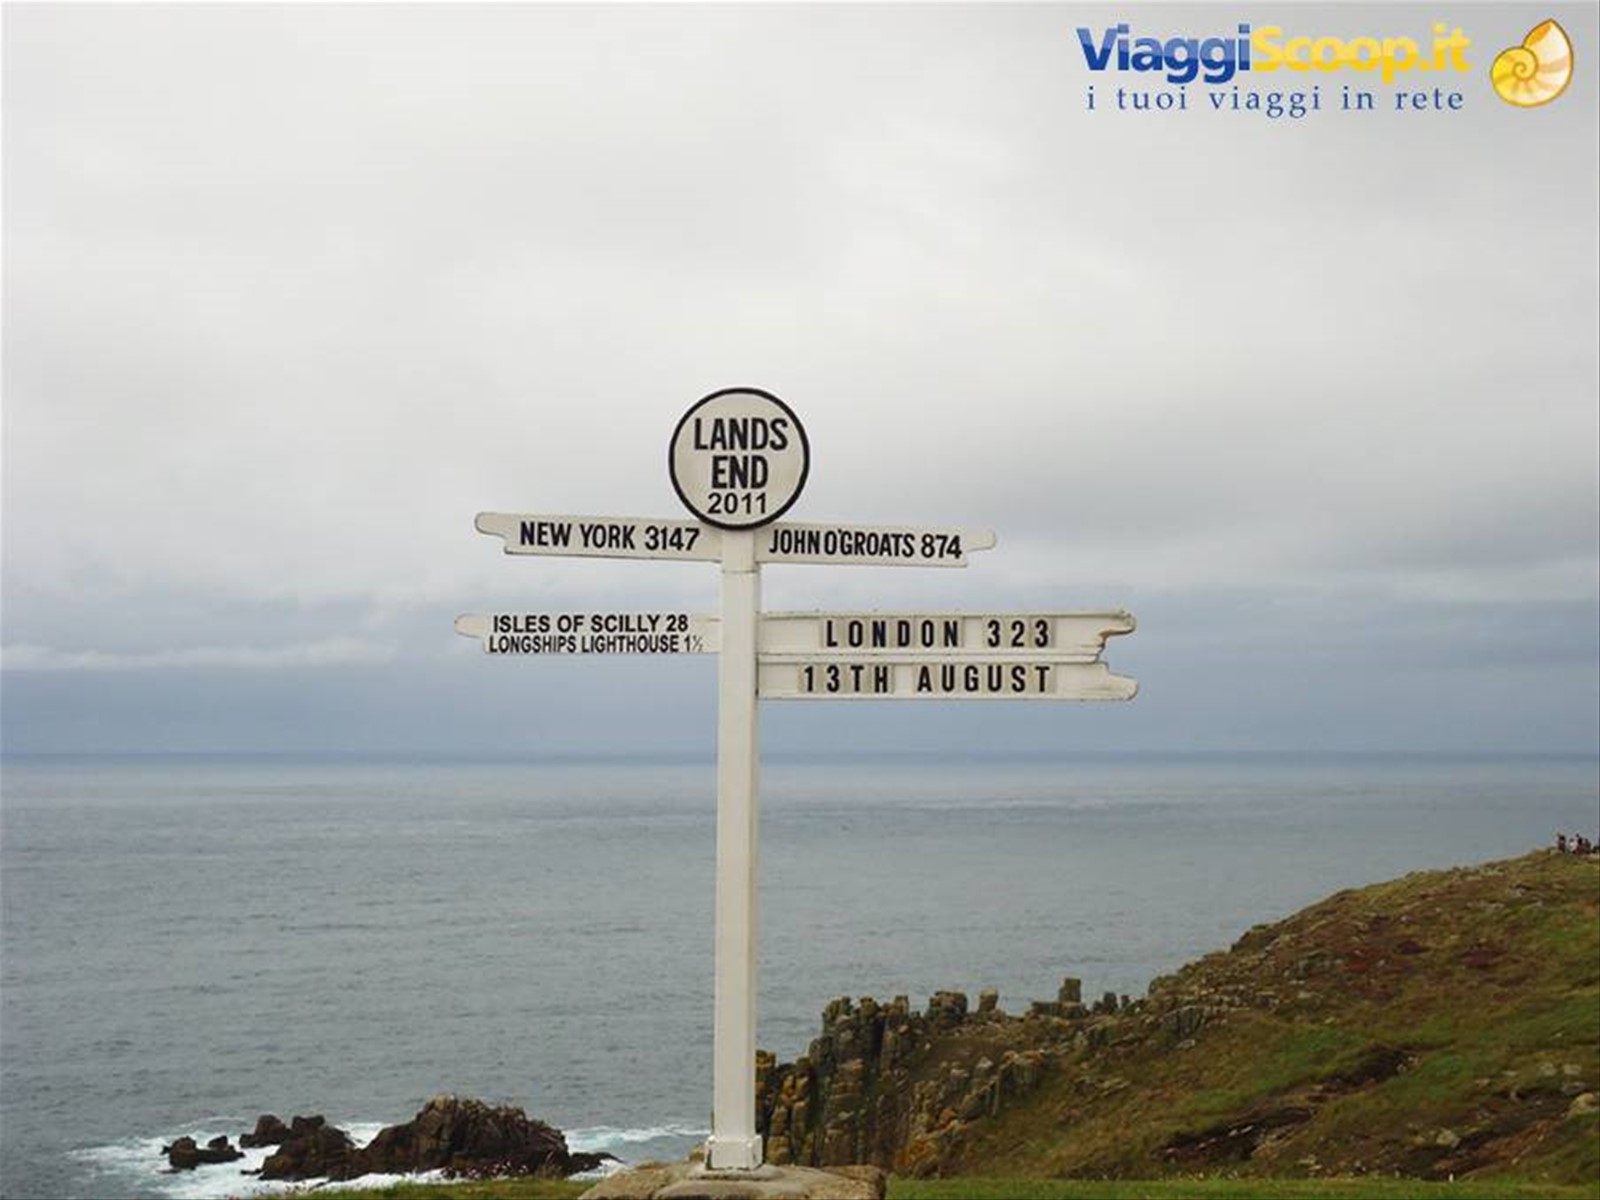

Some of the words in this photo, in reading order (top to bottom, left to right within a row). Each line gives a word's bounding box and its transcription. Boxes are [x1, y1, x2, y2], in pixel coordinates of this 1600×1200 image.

[694, 417, 789, 451] LANDS
[711, 455, 769, 490] END
[707, 492, 767, 515] 2011
[520, 521, 572, 547] NEW
[579, 524, 636, 550] YORK
[644, 527, 700, 552] 3147
[769, 528, 820, 555] JOHN
[920, 533, 963, 560] 874
[493, 615, 551, 633] ISLES
[556, 615, 585, 633] OF
[590, 614, 661, 633] SCILLY
[665, 614, 689, 632] 28
[826, 620, 960, 648] LONDON
[987, 619, 1050, 648] 323
[489, 635, 577, 653] LONGSHIPS
[581, 635, 680, 653] LIGHTHOUSE
[804, 666, 889, 694] 13TH
[917, 665, 1051, 693] AUGUST
